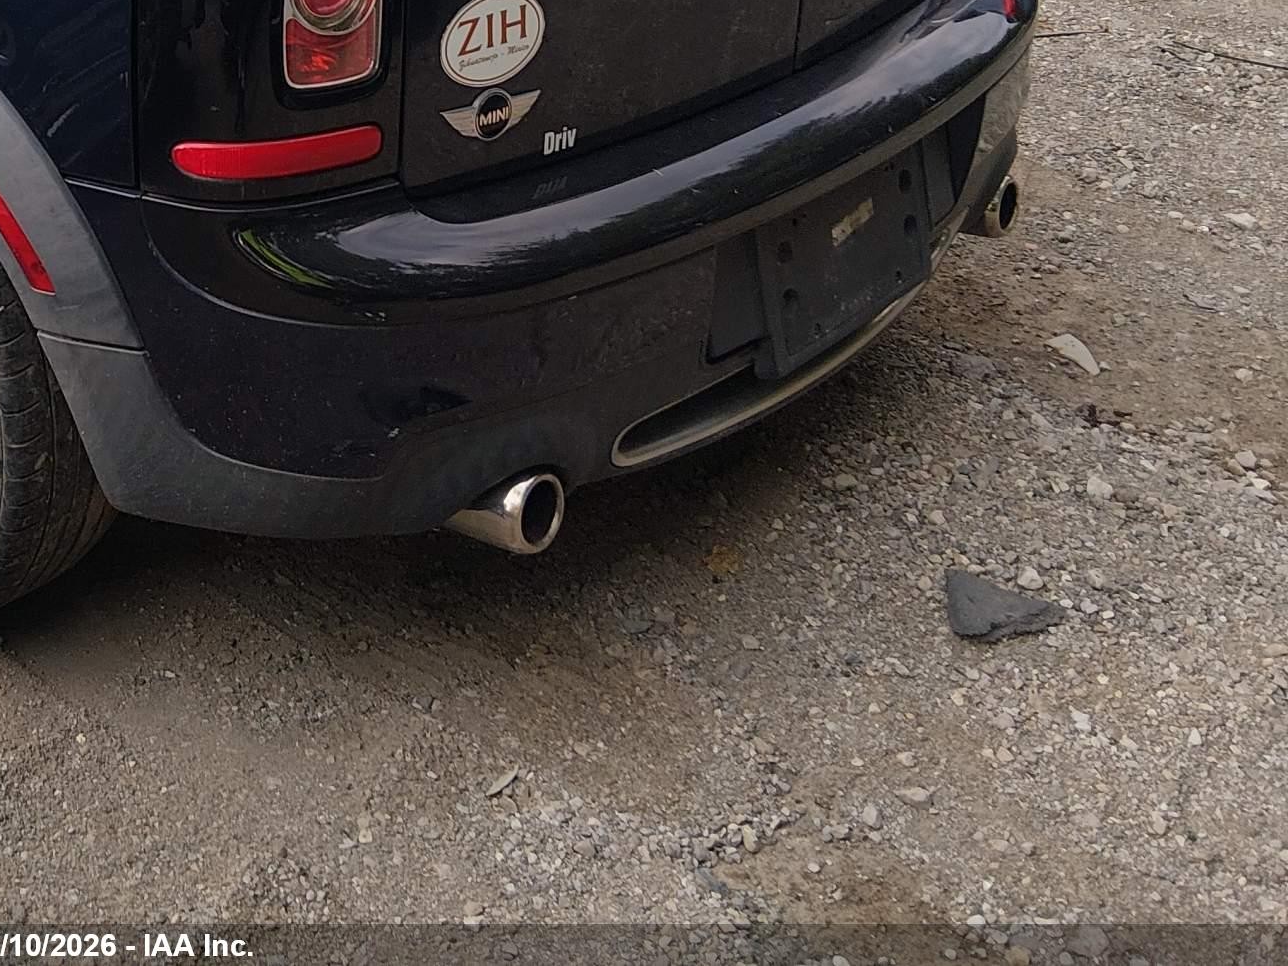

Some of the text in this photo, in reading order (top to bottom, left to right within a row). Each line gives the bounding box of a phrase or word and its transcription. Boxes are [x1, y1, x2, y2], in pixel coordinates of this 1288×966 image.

[457, 4, 528, 56] ZIH
[479, 106, 509, 126] MINI
[543, 126, 577, 156] Driv
